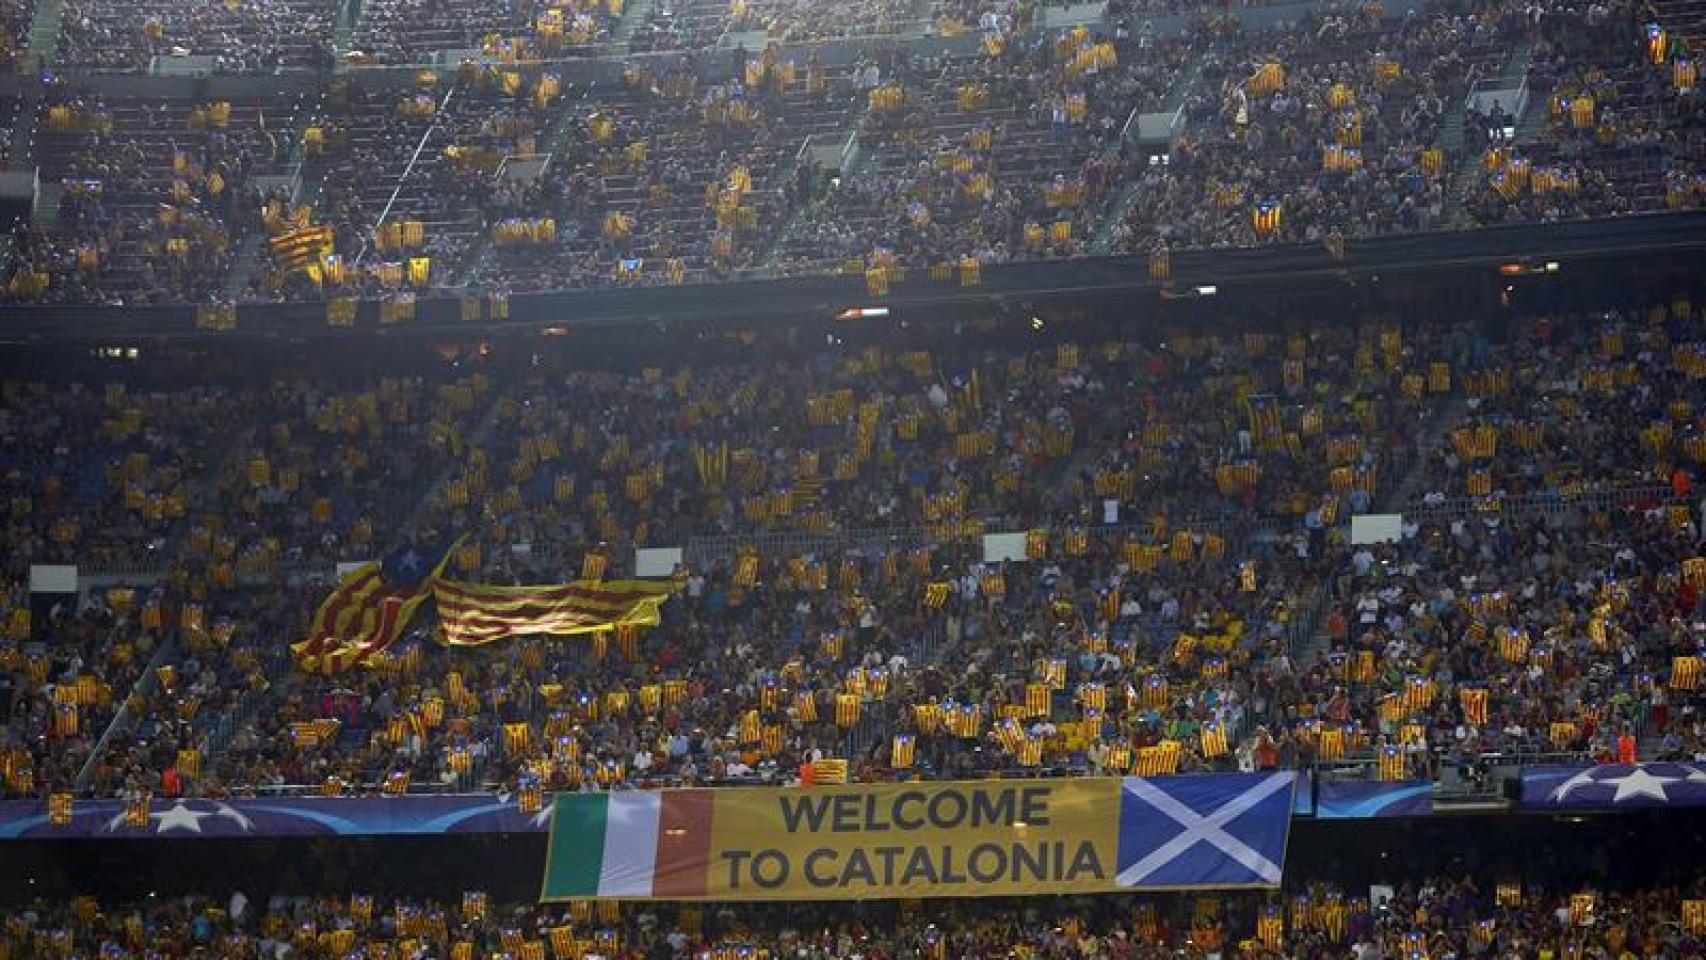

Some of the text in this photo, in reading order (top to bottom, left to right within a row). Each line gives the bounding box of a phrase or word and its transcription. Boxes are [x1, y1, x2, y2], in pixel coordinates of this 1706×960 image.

[780, 788, 1051, 833] WELCOME
[721, 840, 1105, 888] TO CATALONIA
